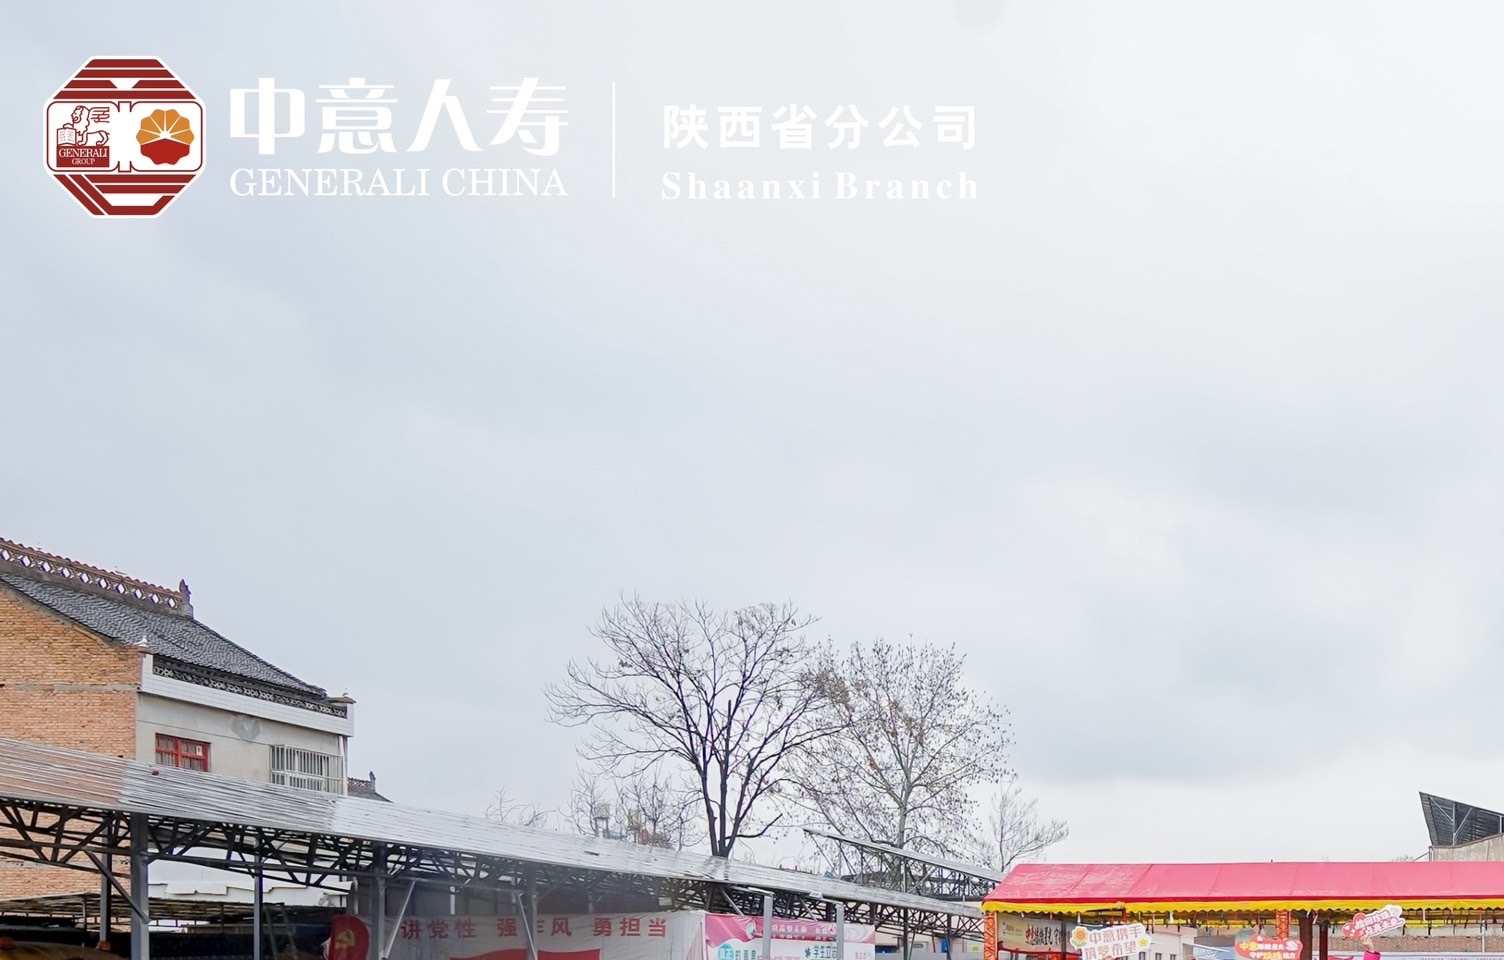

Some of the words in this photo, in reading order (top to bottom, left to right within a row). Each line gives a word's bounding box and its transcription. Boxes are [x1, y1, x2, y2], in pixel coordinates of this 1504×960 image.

[593, 917, 668, 938] 勇担当
[1089, 925, 1142, 945] 中意携手
[1084, 942, 1137, 960] 筑梦希望
